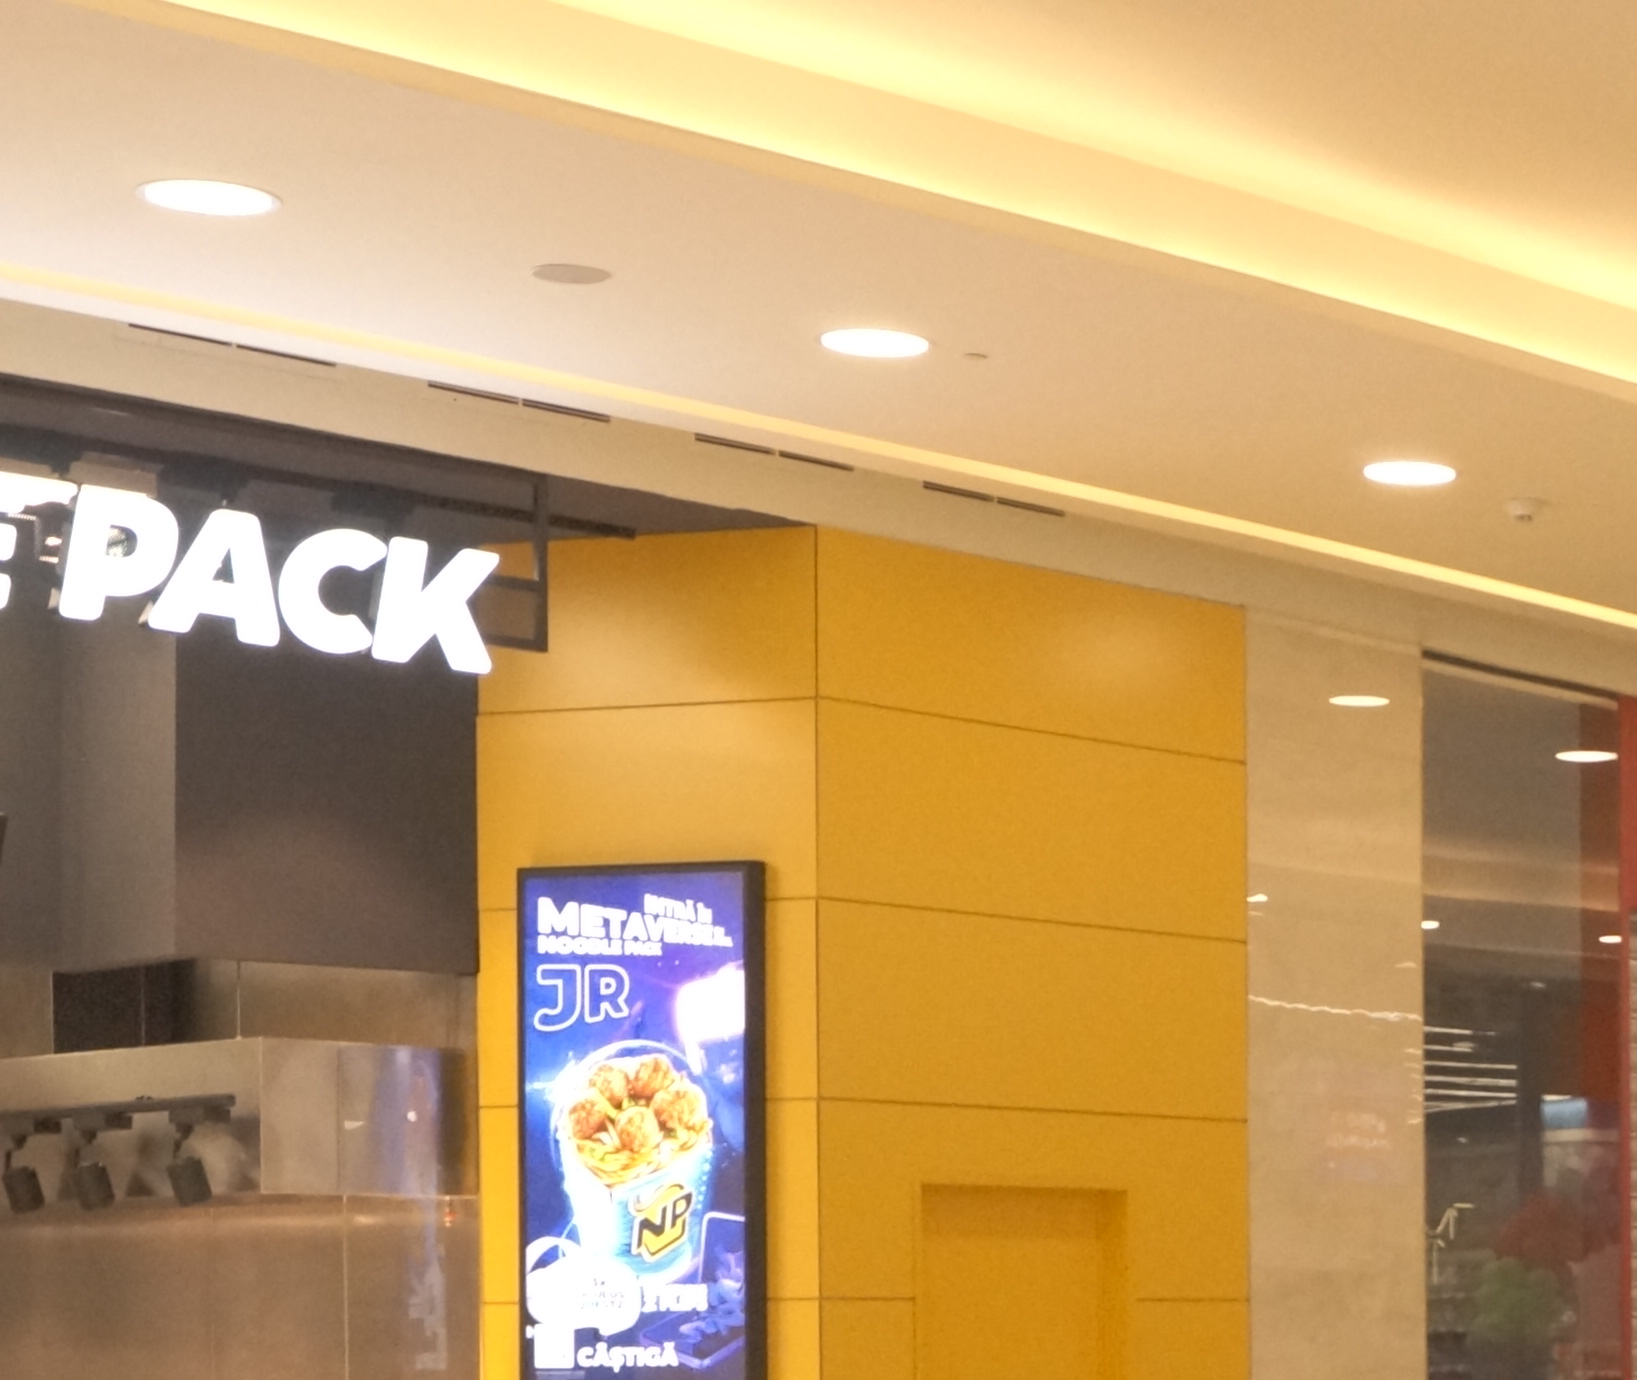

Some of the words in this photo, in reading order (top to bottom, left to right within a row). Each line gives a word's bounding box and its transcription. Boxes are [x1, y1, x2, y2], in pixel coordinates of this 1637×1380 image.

[59, 483, 500, 675] PACK
[537, 934, 623, 956] NOODLE
[624, 939, 663, 956] PACK
[533, 963, 630, 1032] JR
